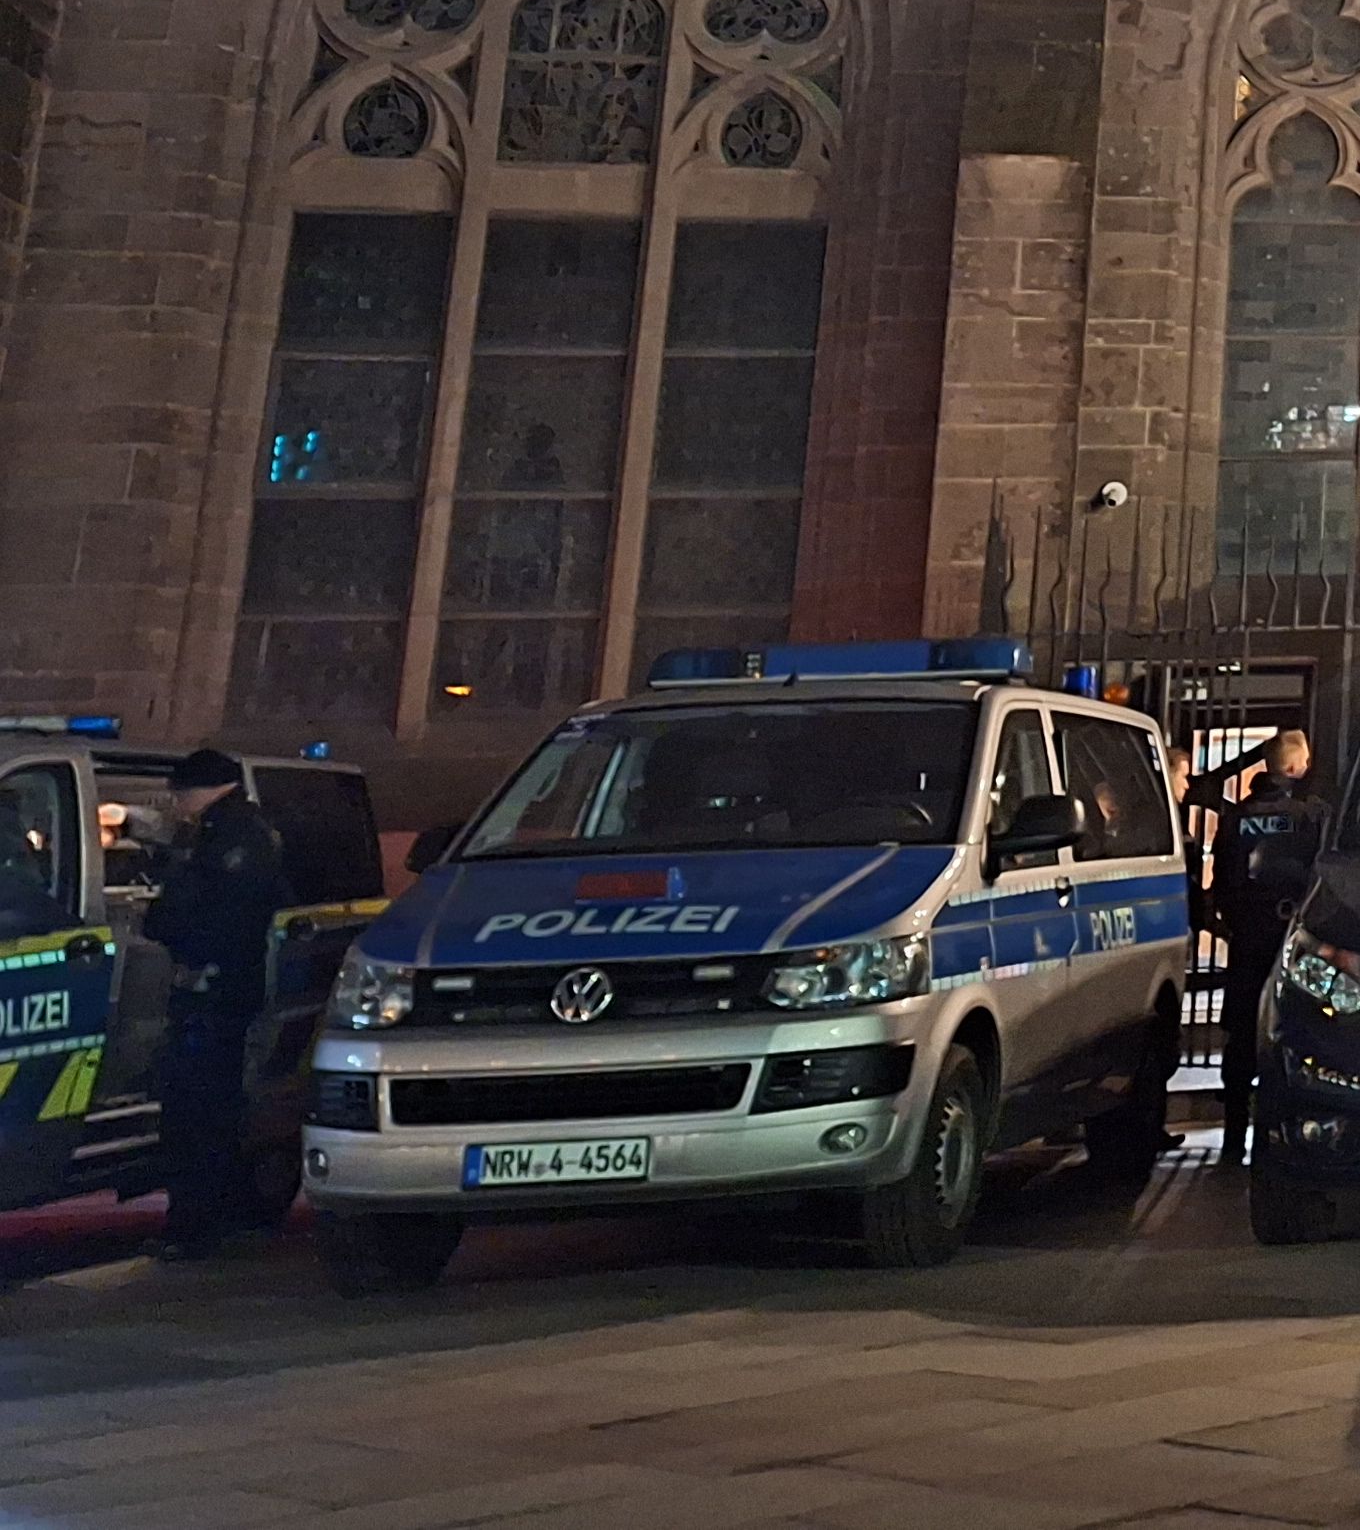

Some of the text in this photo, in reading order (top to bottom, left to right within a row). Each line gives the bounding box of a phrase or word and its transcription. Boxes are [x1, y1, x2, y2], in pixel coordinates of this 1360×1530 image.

[473, 904, 740, 943] POLIZEI
[483, 1143, 643, 1180] NRW 4-4564
